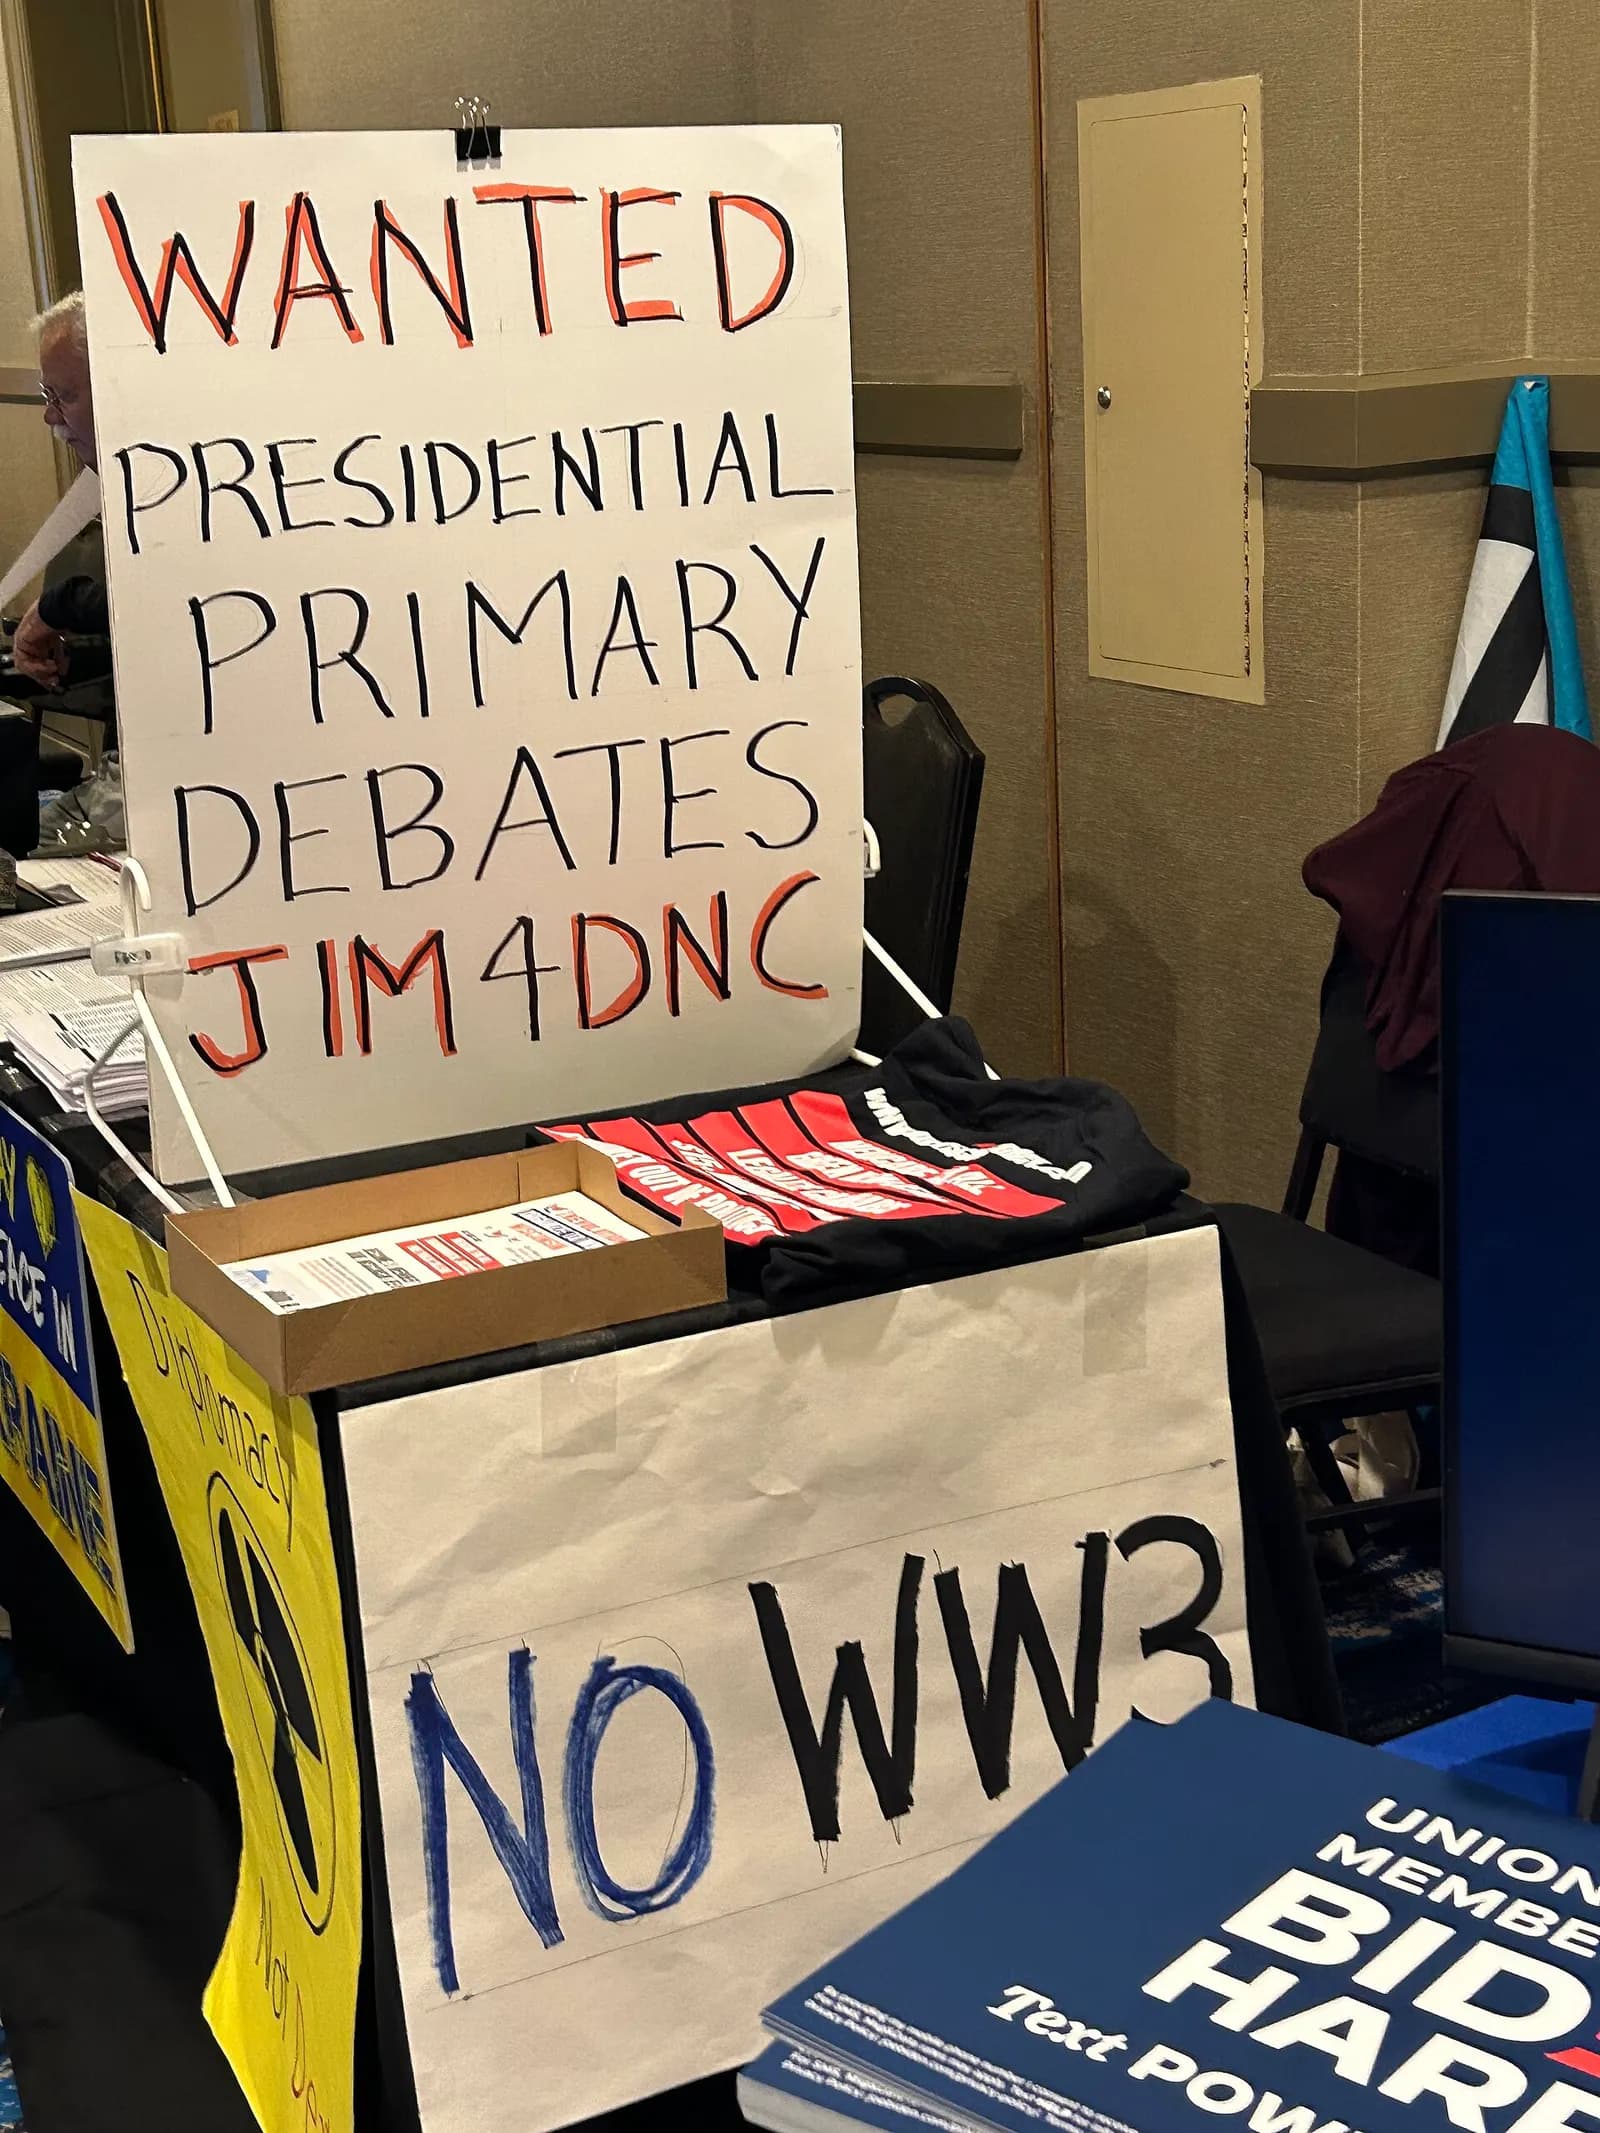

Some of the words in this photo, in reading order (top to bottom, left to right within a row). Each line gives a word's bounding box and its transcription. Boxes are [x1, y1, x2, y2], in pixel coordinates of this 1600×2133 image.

[96, 183, 795, 354] WANTED
[115, 412, 834, 554] PRESIDENTIAL
[191, 537, 825, 734] PRIMARY
[174, 720, 820, 916] DEBATES
[51, 1286, 78, 1373] IN
[126, 1270, 293, 1552] Diplomacy
[405, 1647, 716, 1994] NO
[748, 1515, 1233, 1842] WW3
[255, 1876, 290, 2041] Not
[1315, 1833, 1600, 1958] MEMBE
[986, 1985, 1128, 2063] Text
[1127, 2043, 1362, 2133] POW
